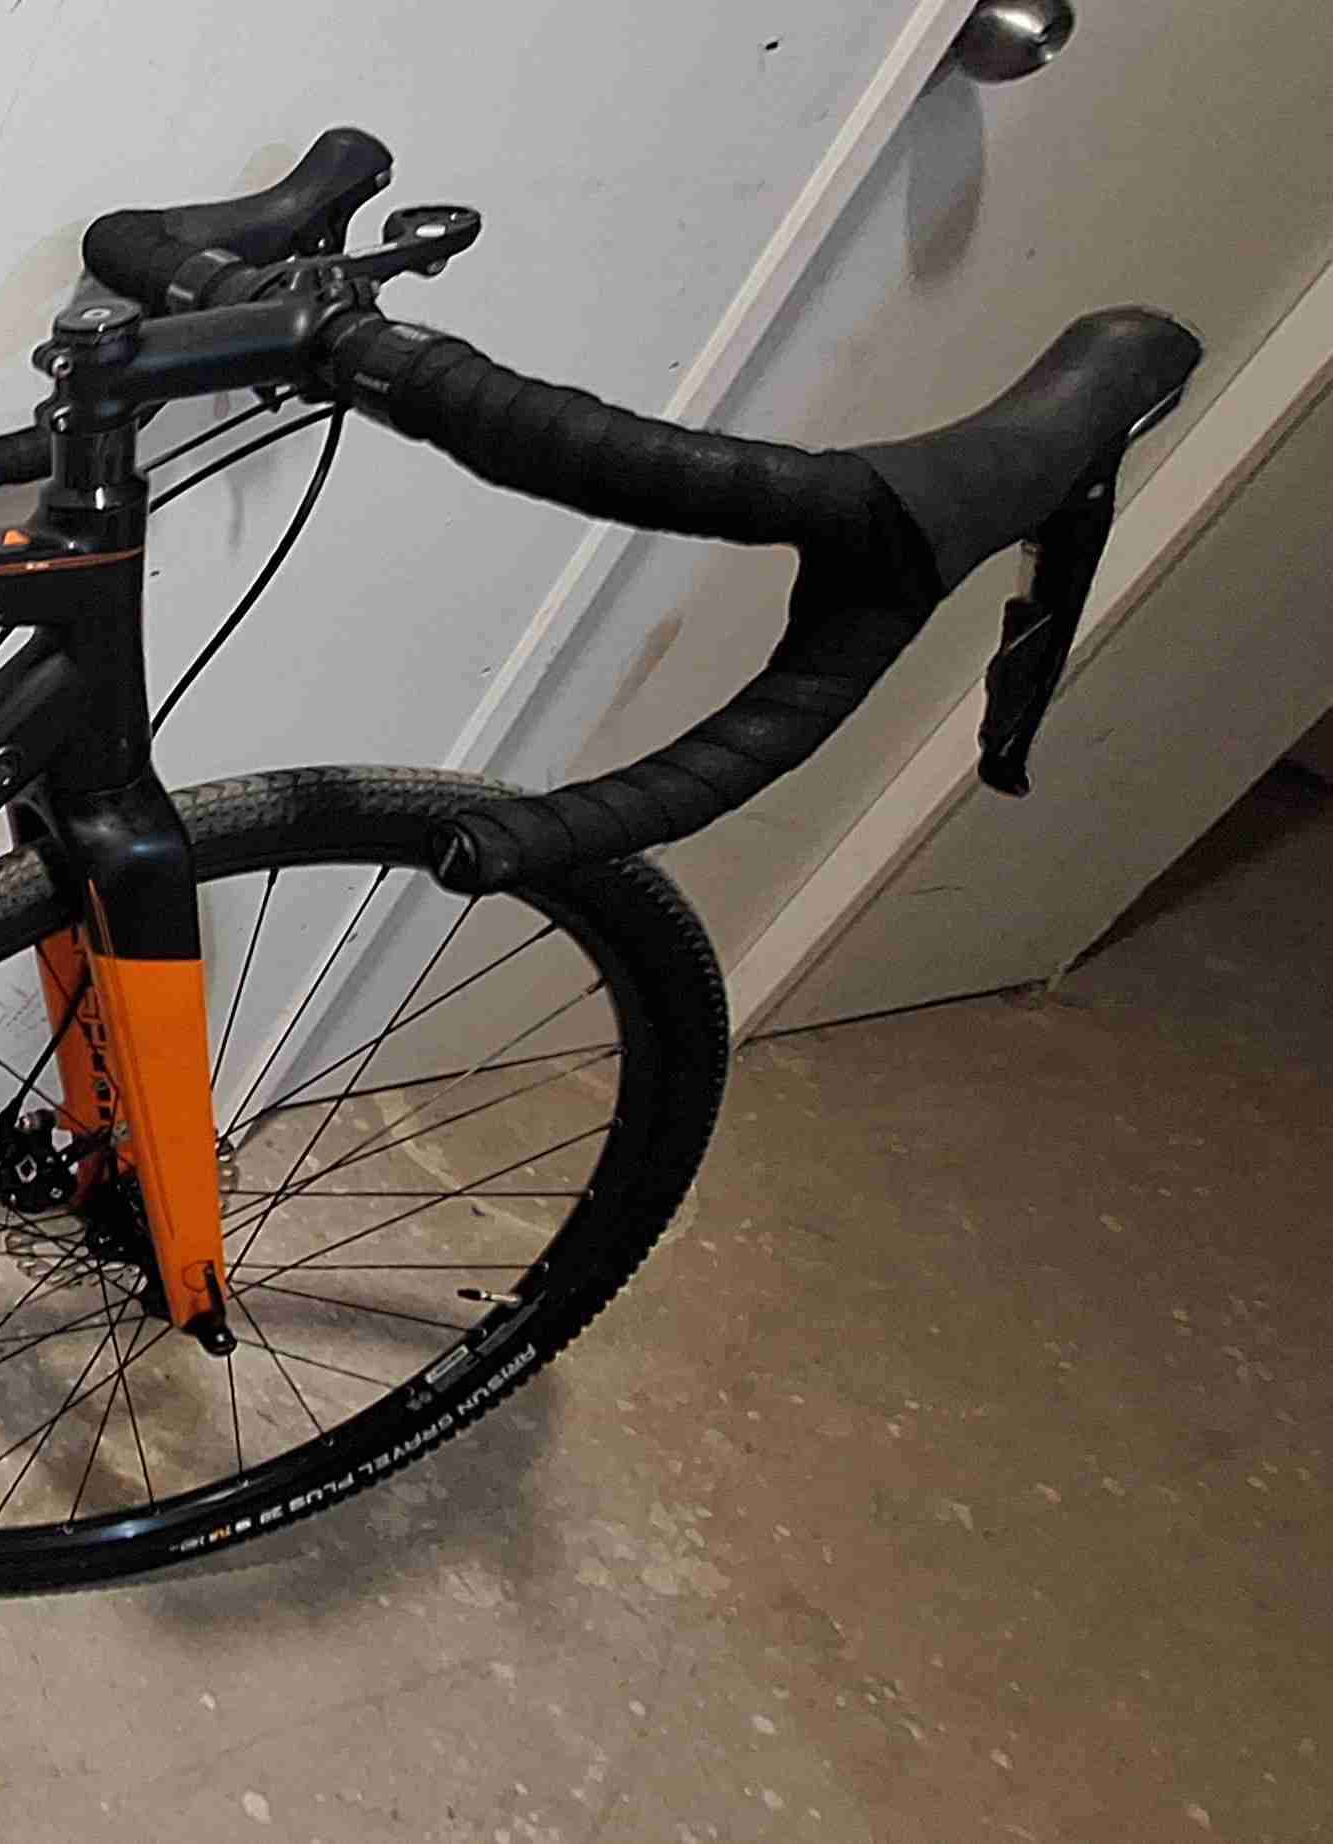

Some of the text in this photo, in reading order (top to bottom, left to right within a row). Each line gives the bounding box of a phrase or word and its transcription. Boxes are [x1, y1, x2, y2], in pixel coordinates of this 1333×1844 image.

[456, 1343, 536, 1416] ARISUN
[357, 1412, 454, 1475] GRAVEL
[288, 1472, 355, 1513] PLUS
